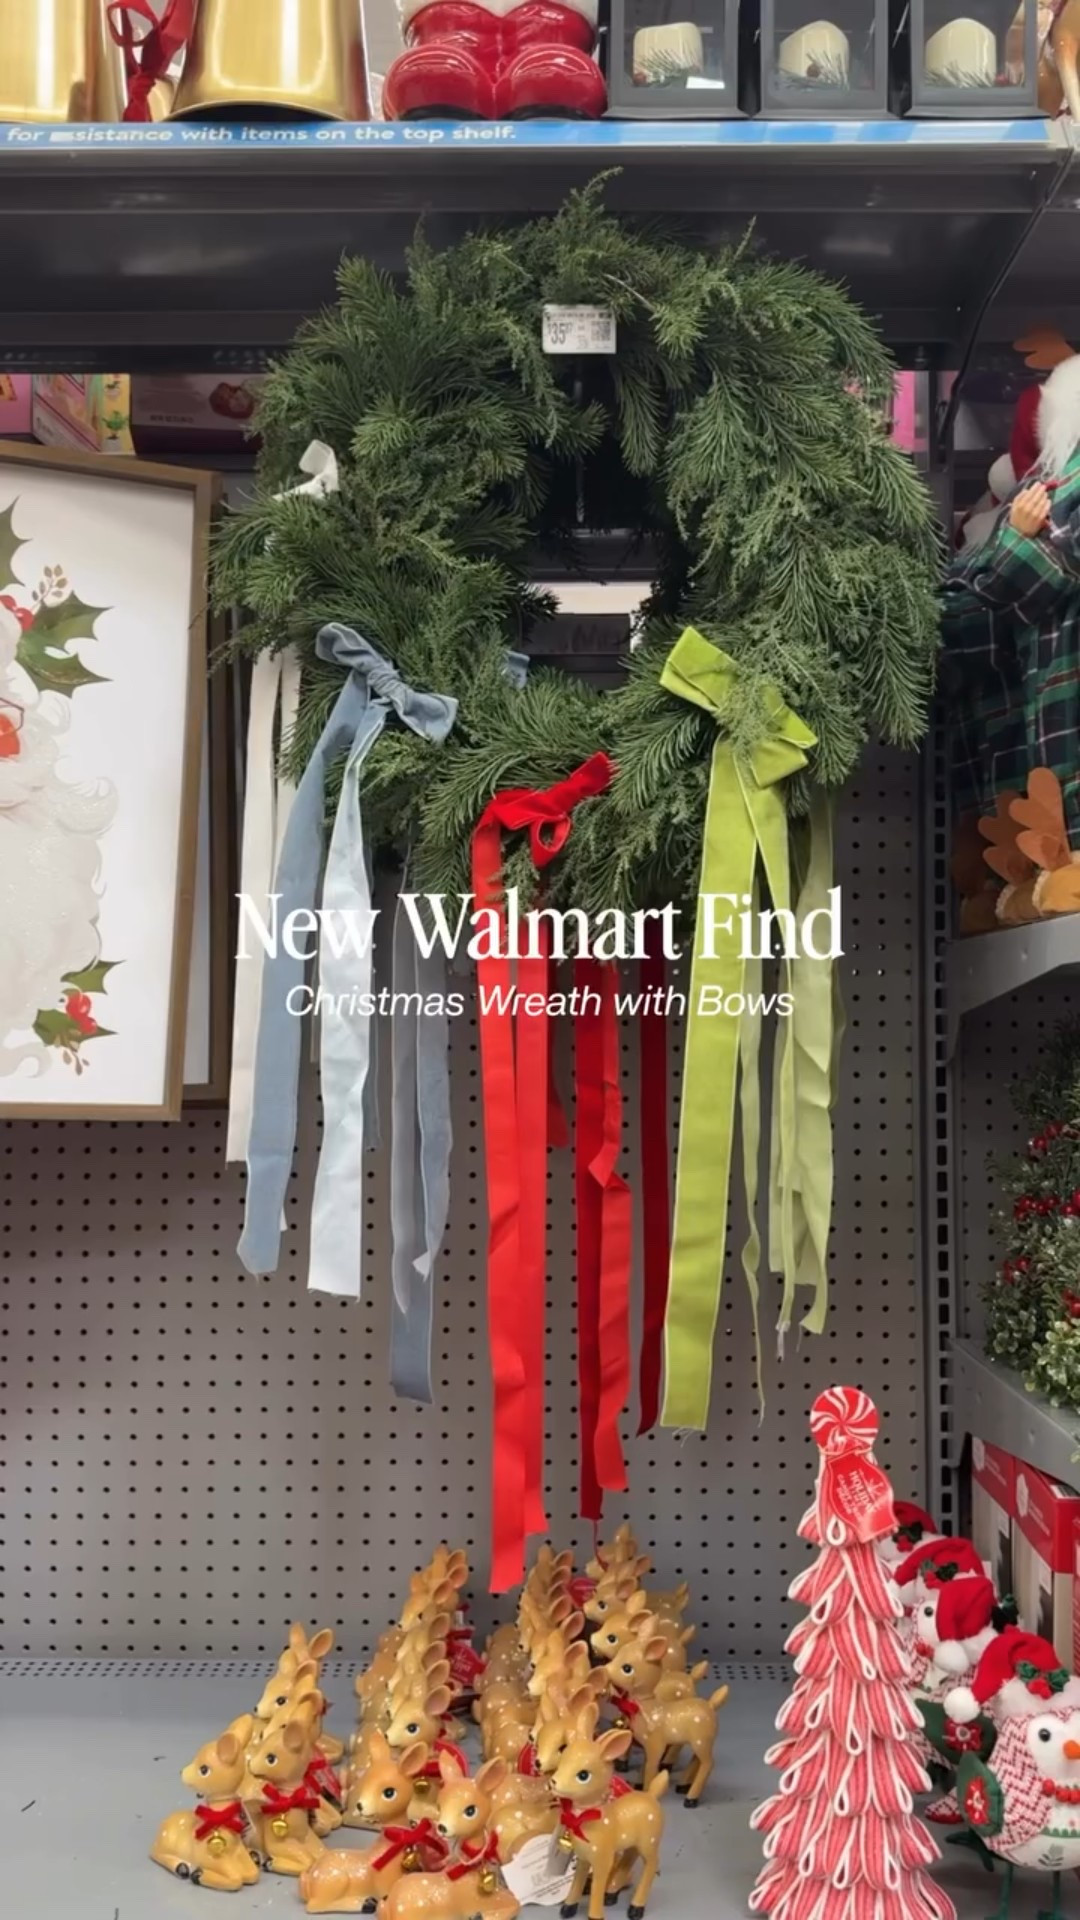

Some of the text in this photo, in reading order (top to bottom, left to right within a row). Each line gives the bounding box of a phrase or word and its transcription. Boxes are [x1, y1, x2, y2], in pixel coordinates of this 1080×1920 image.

[7, 126, 516, 142] for sistance with items on the top shelf.
